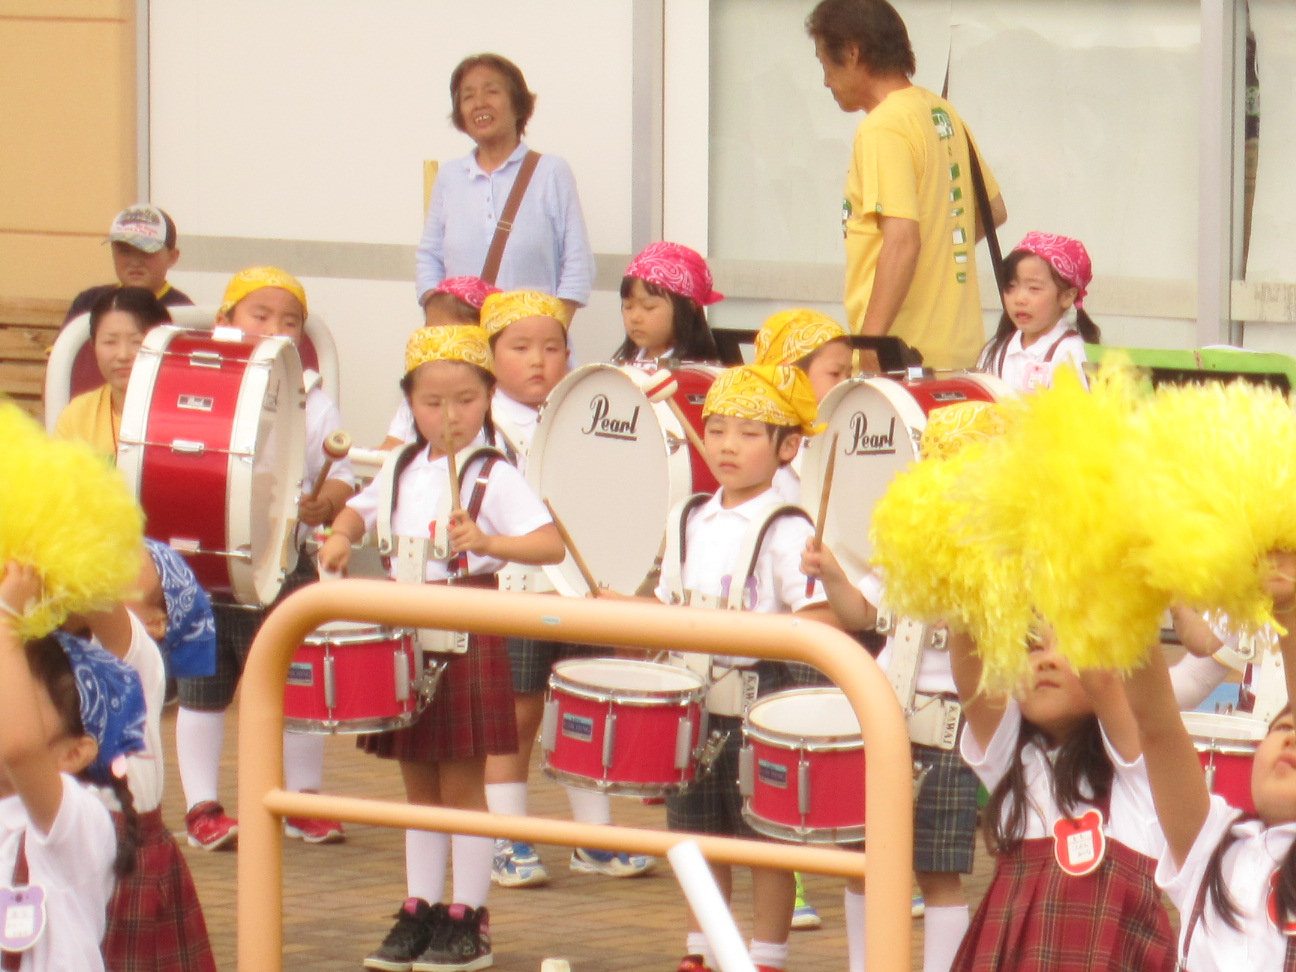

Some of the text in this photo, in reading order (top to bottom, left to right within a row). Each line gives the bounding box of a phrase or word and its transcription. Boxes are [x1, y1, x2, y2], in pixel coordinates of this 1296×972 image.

[581, 393, 640, 435] Pearl
[844, 410, 896, 456] Pearl
[943, 704, 958, 745] KAWAI
